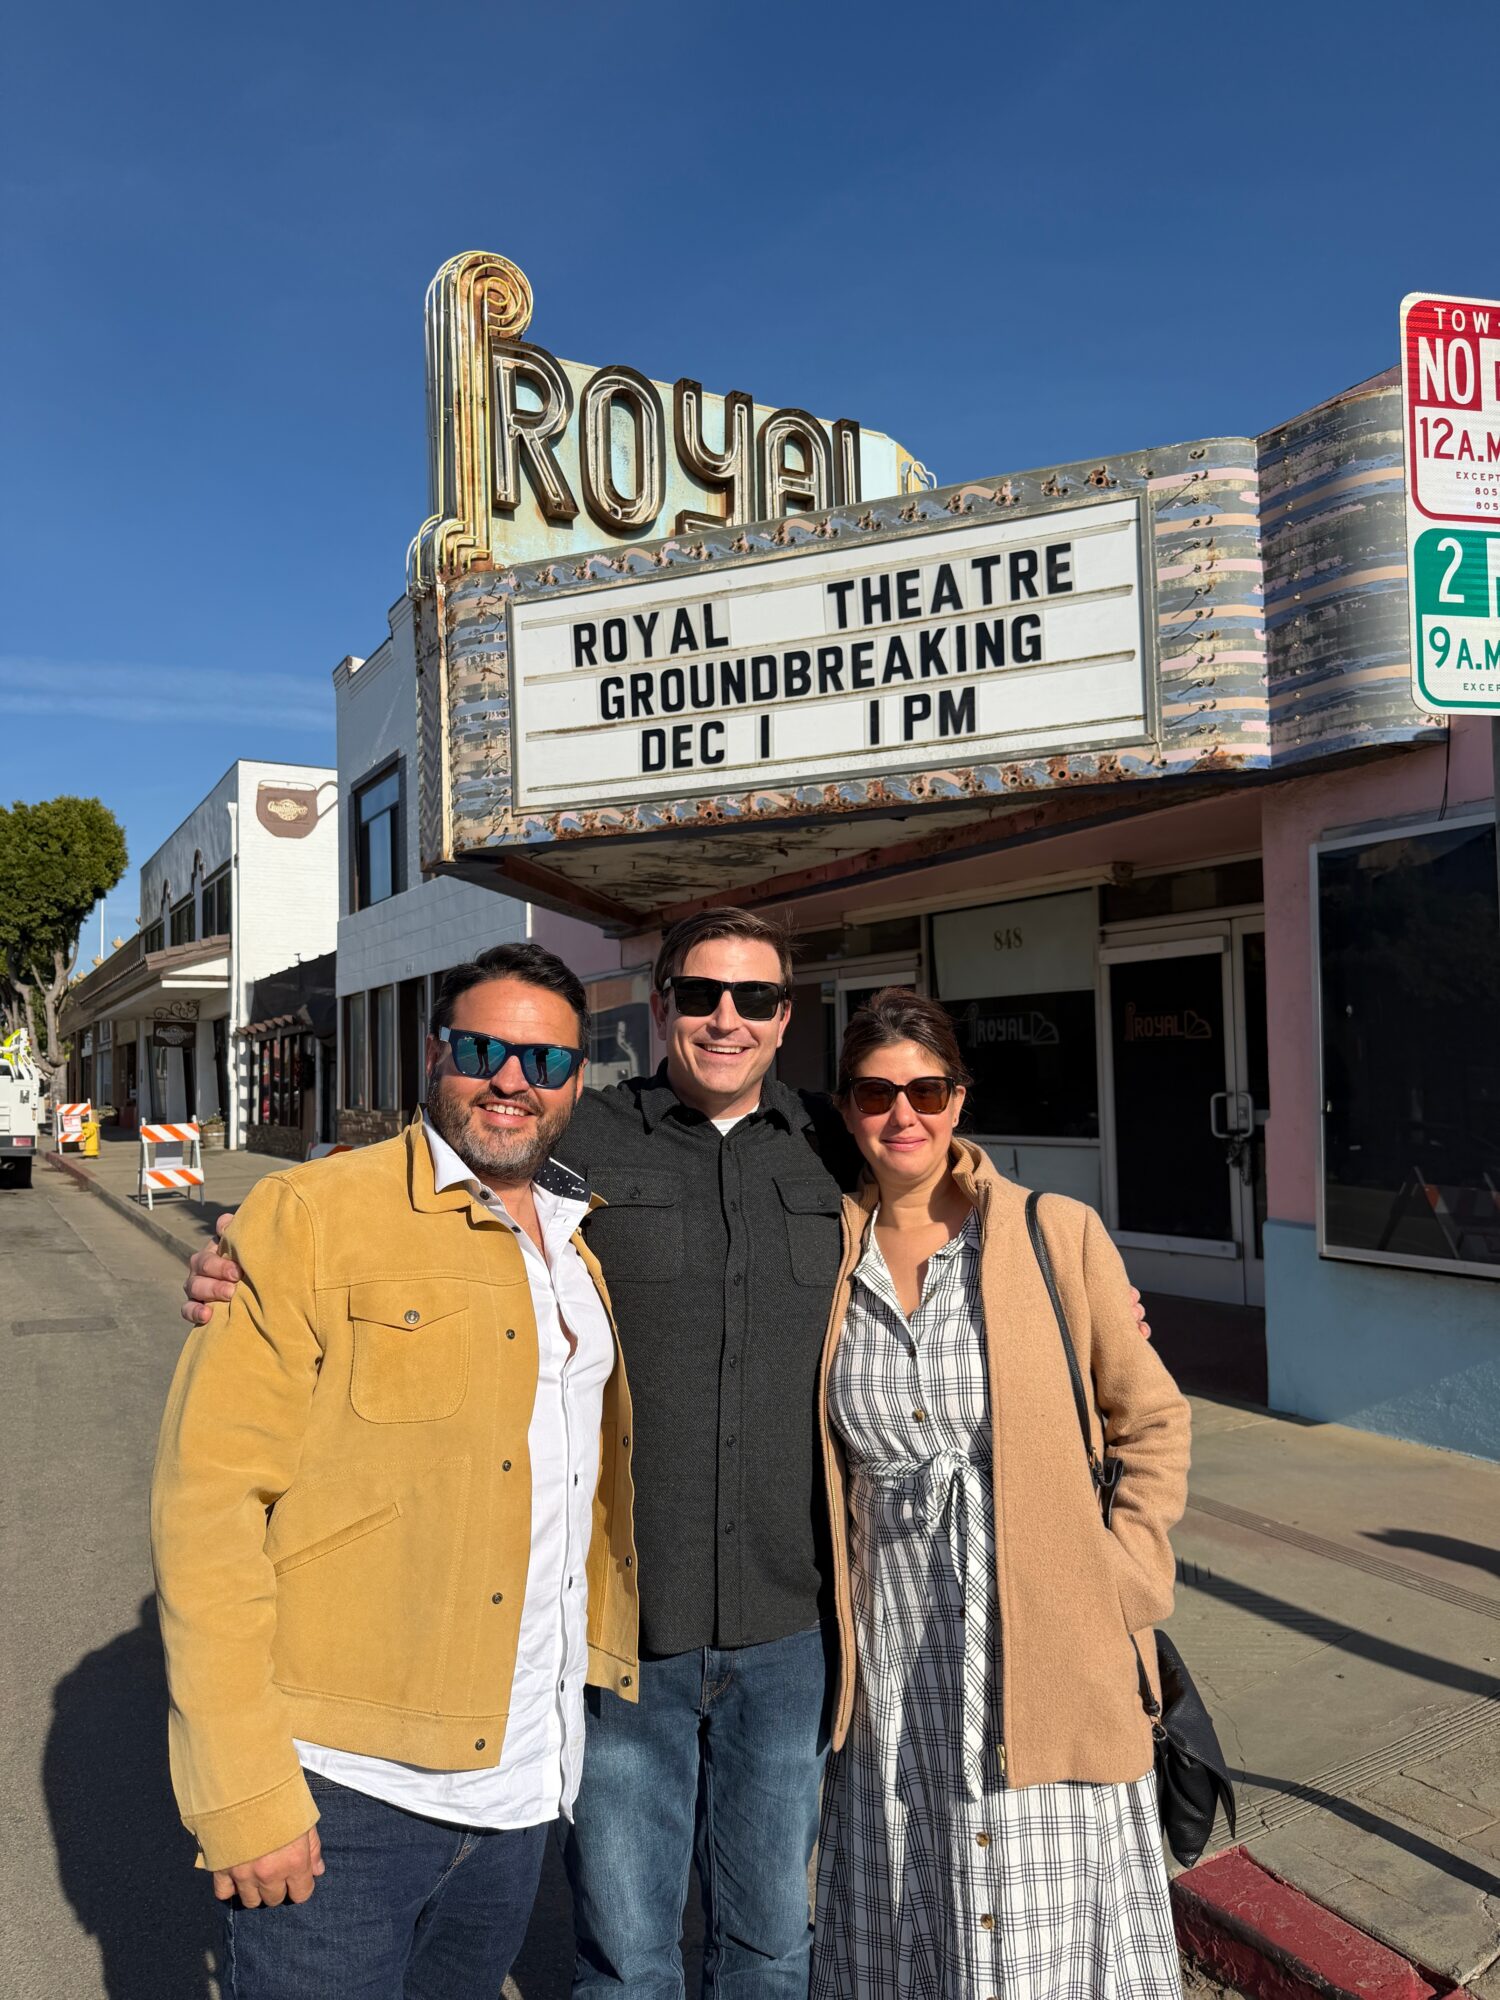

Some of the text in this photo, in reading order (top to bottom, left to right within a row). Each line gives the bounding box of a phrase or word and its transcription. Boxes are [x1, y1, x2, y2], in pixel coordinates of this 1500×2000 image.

[1419, 337, 1475, 404] NO
[492, 337, 862, 536] ROYAL
[1437, 537, 1465, 603] 2
[573, 543, 1073, 668] ROYAL THEATRE
[600, 614, 1043, 721] GROUNDBREAKING
[641, 721, 725, 773] DEC
[904, 687, 976, 741] PM
[994, 927, 1023, 950] 848
[978, 1016, 1030, 1042] ROYAL
[1134, 1015, 1184, 1036] ROYAL
